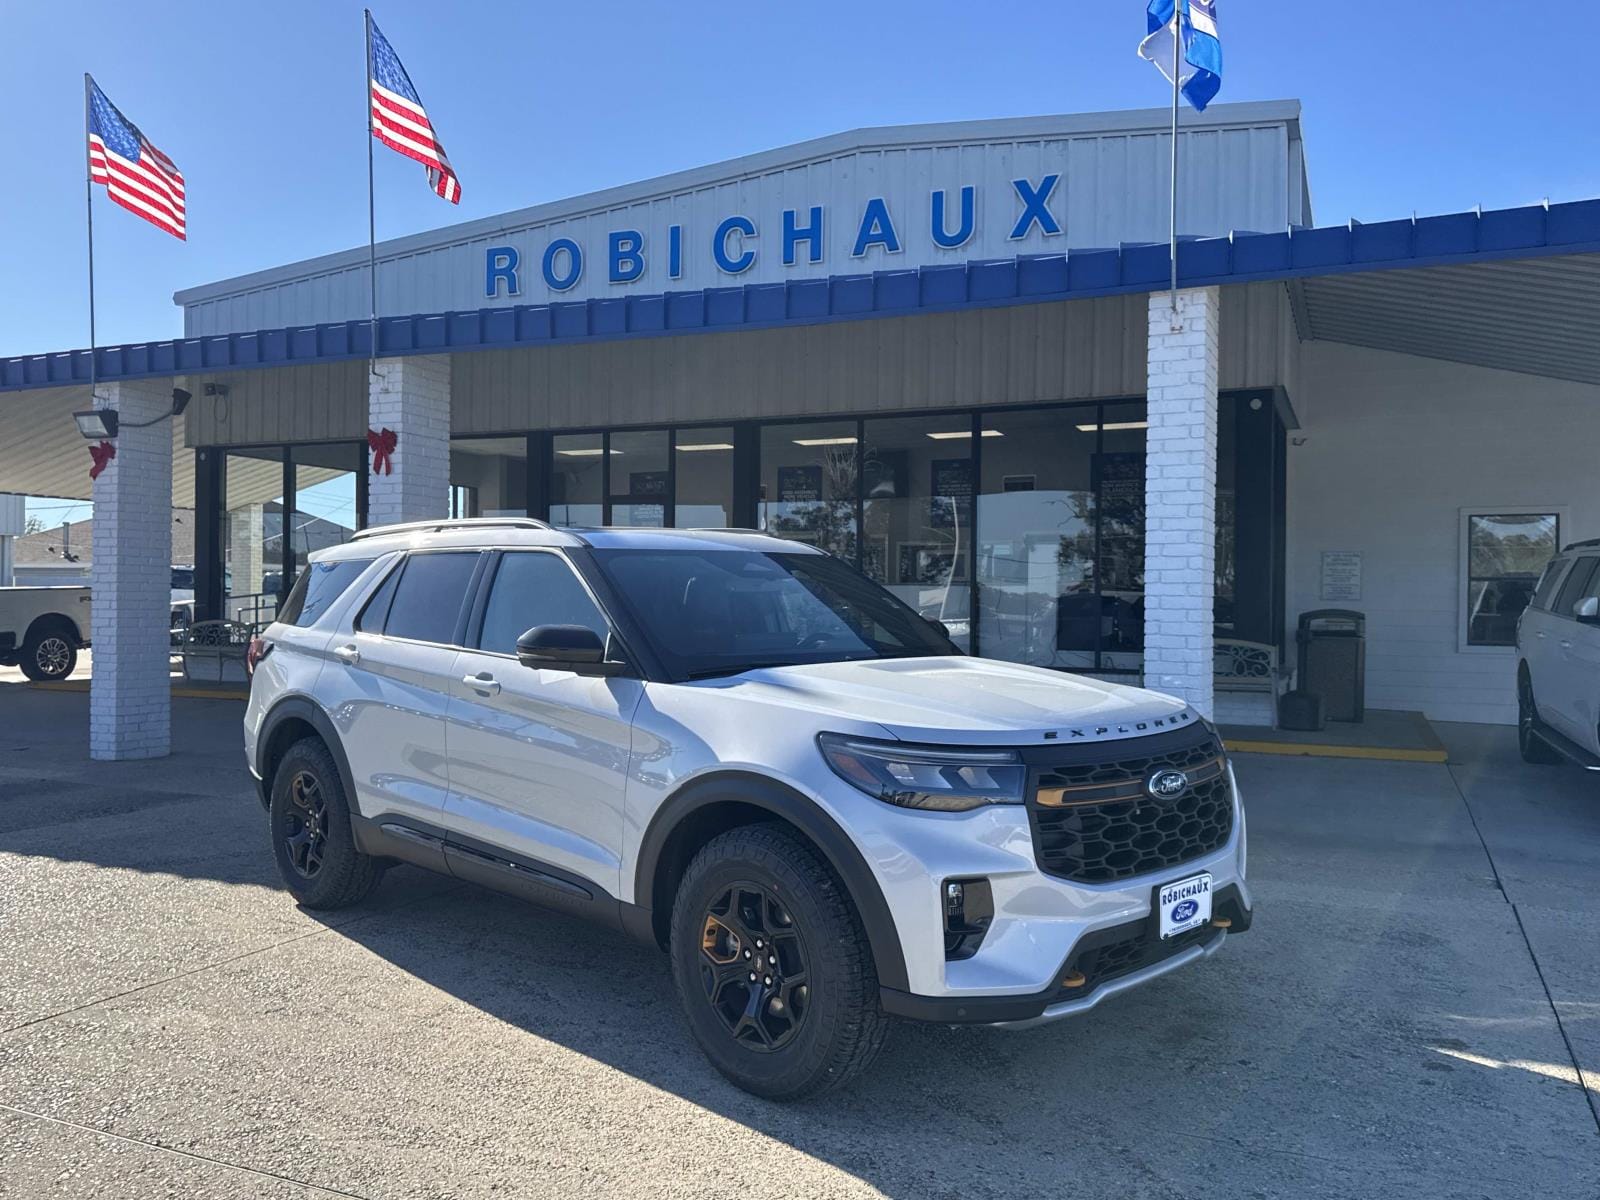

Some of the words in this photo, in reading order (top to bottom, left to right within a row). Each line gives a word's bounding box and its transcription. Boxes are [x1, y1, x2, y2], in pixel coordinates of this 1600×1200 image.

[484, 173, 1063, 298] ROBICHAUX
[1043, 712, 1189, 740] EXPLORER
[1162, 881, 1209, 906] ROBICHAUX
